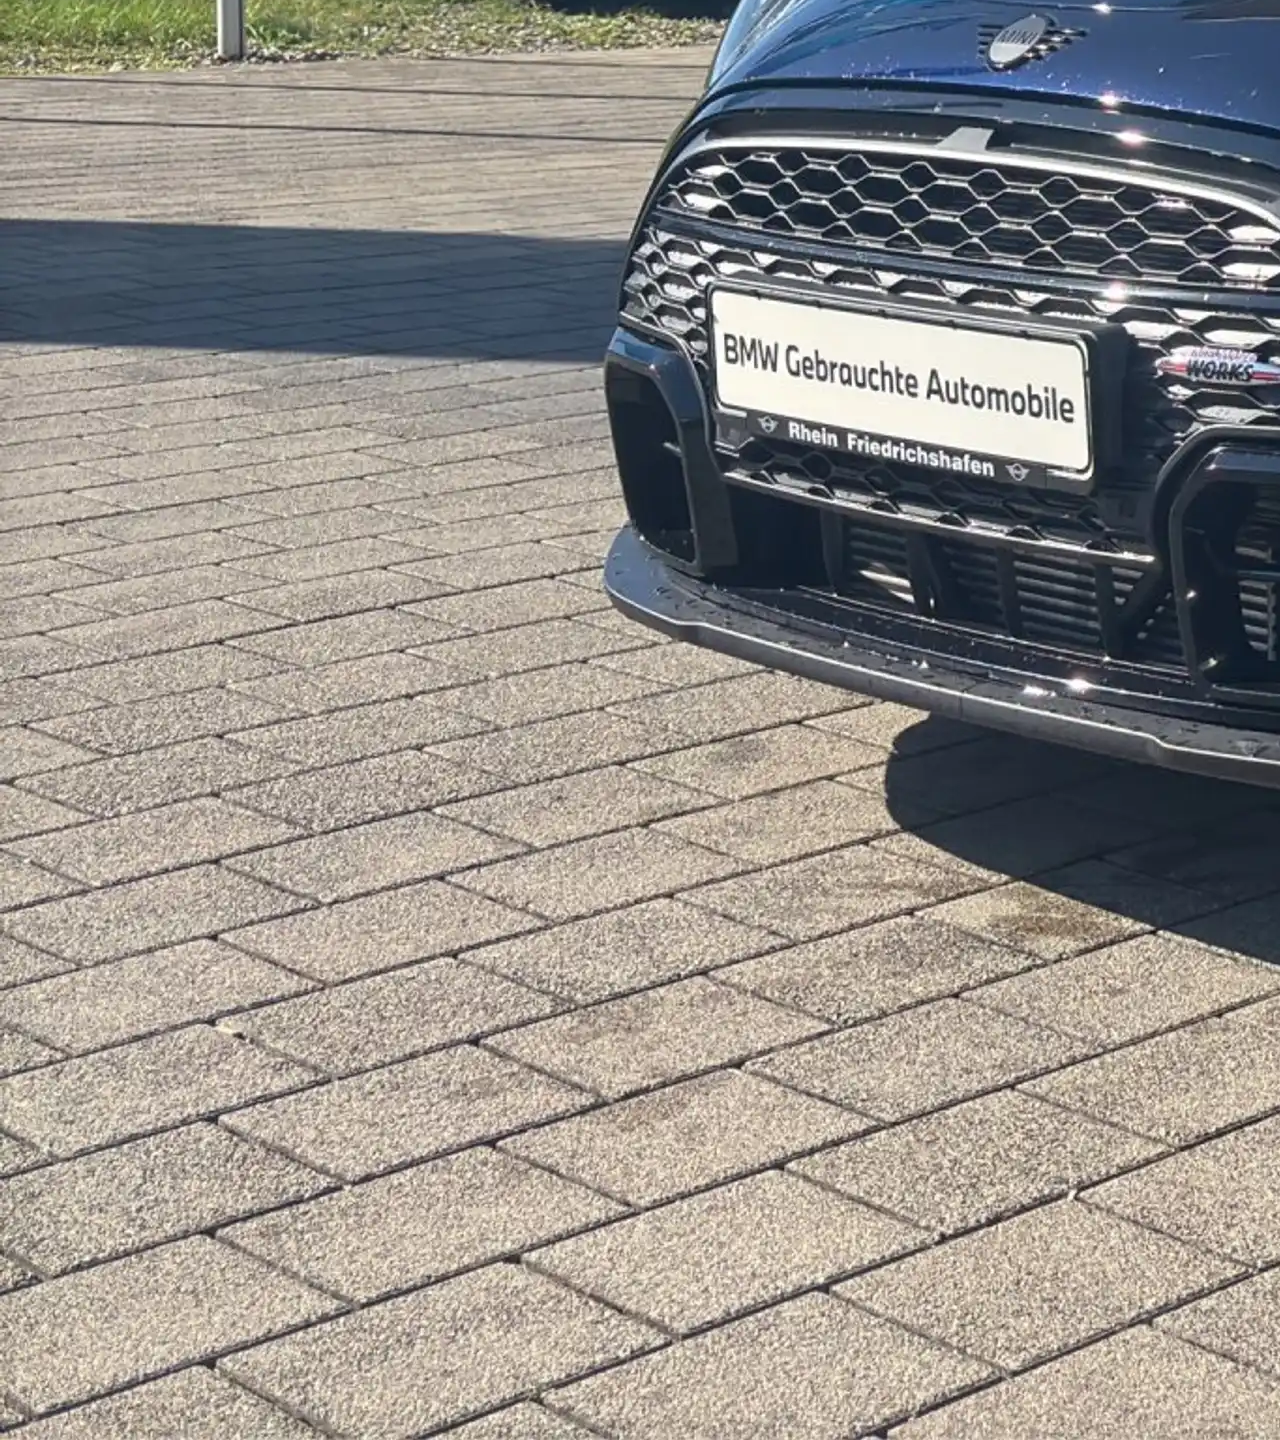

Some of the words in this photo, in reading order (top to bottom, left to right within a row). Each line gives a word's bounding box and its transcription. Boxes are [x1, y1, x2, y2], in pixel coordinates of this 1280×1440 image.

[997, 27, 1040, 45] MINI
[723, 333, 779, 372] BMW
[785, 345, 919, 399] Gebrauchte
[925, 368, 1075, 424] Automobile
[1187, 359, 1254, 382] WORKS
[788, 421, 838, 448] Rhein
[846, 433, 995, 478] Friedrichshafen
